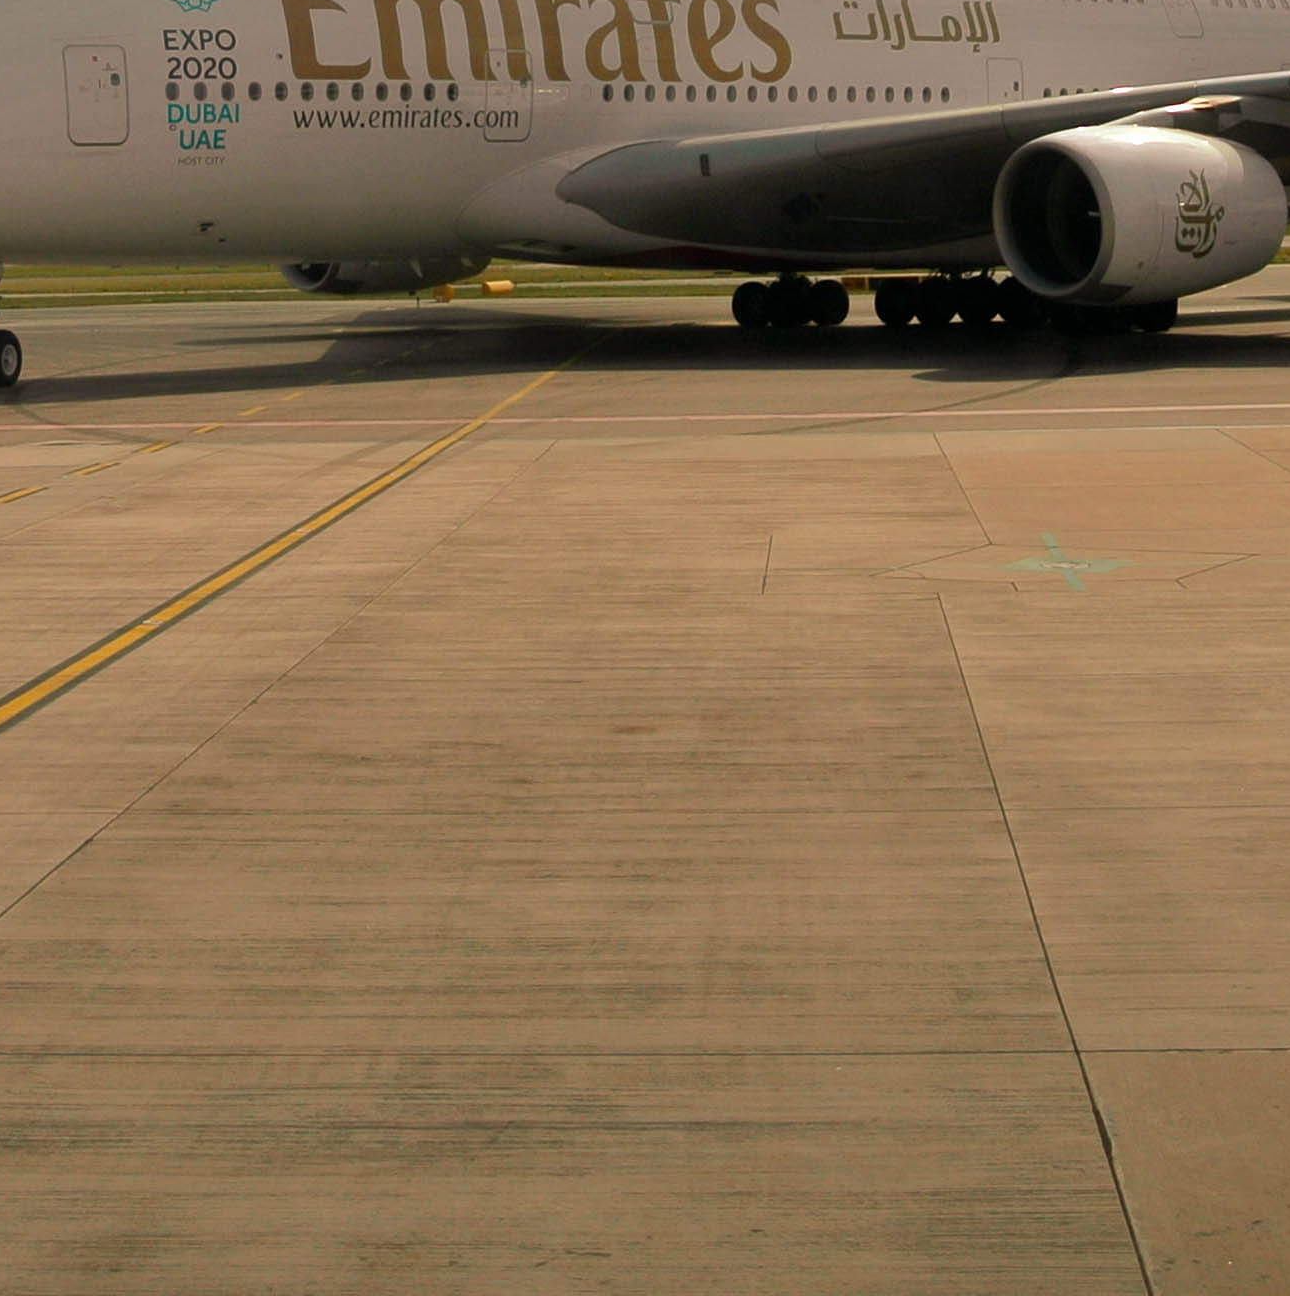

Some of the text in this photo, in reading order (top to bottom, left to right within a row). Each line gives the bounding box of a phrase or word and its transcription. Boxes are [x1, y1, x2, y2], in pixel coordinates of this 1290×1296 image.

[163, 29, 236, 51] EXPO
[167, 57, 237, 79] 2020
[167, 104, 240, 124] DUBAI
[293, 104, 519, 129] www.emirates.com
[179, 129, 226, 150] UAE
[178, 156, 225, 166] HOST CITY
